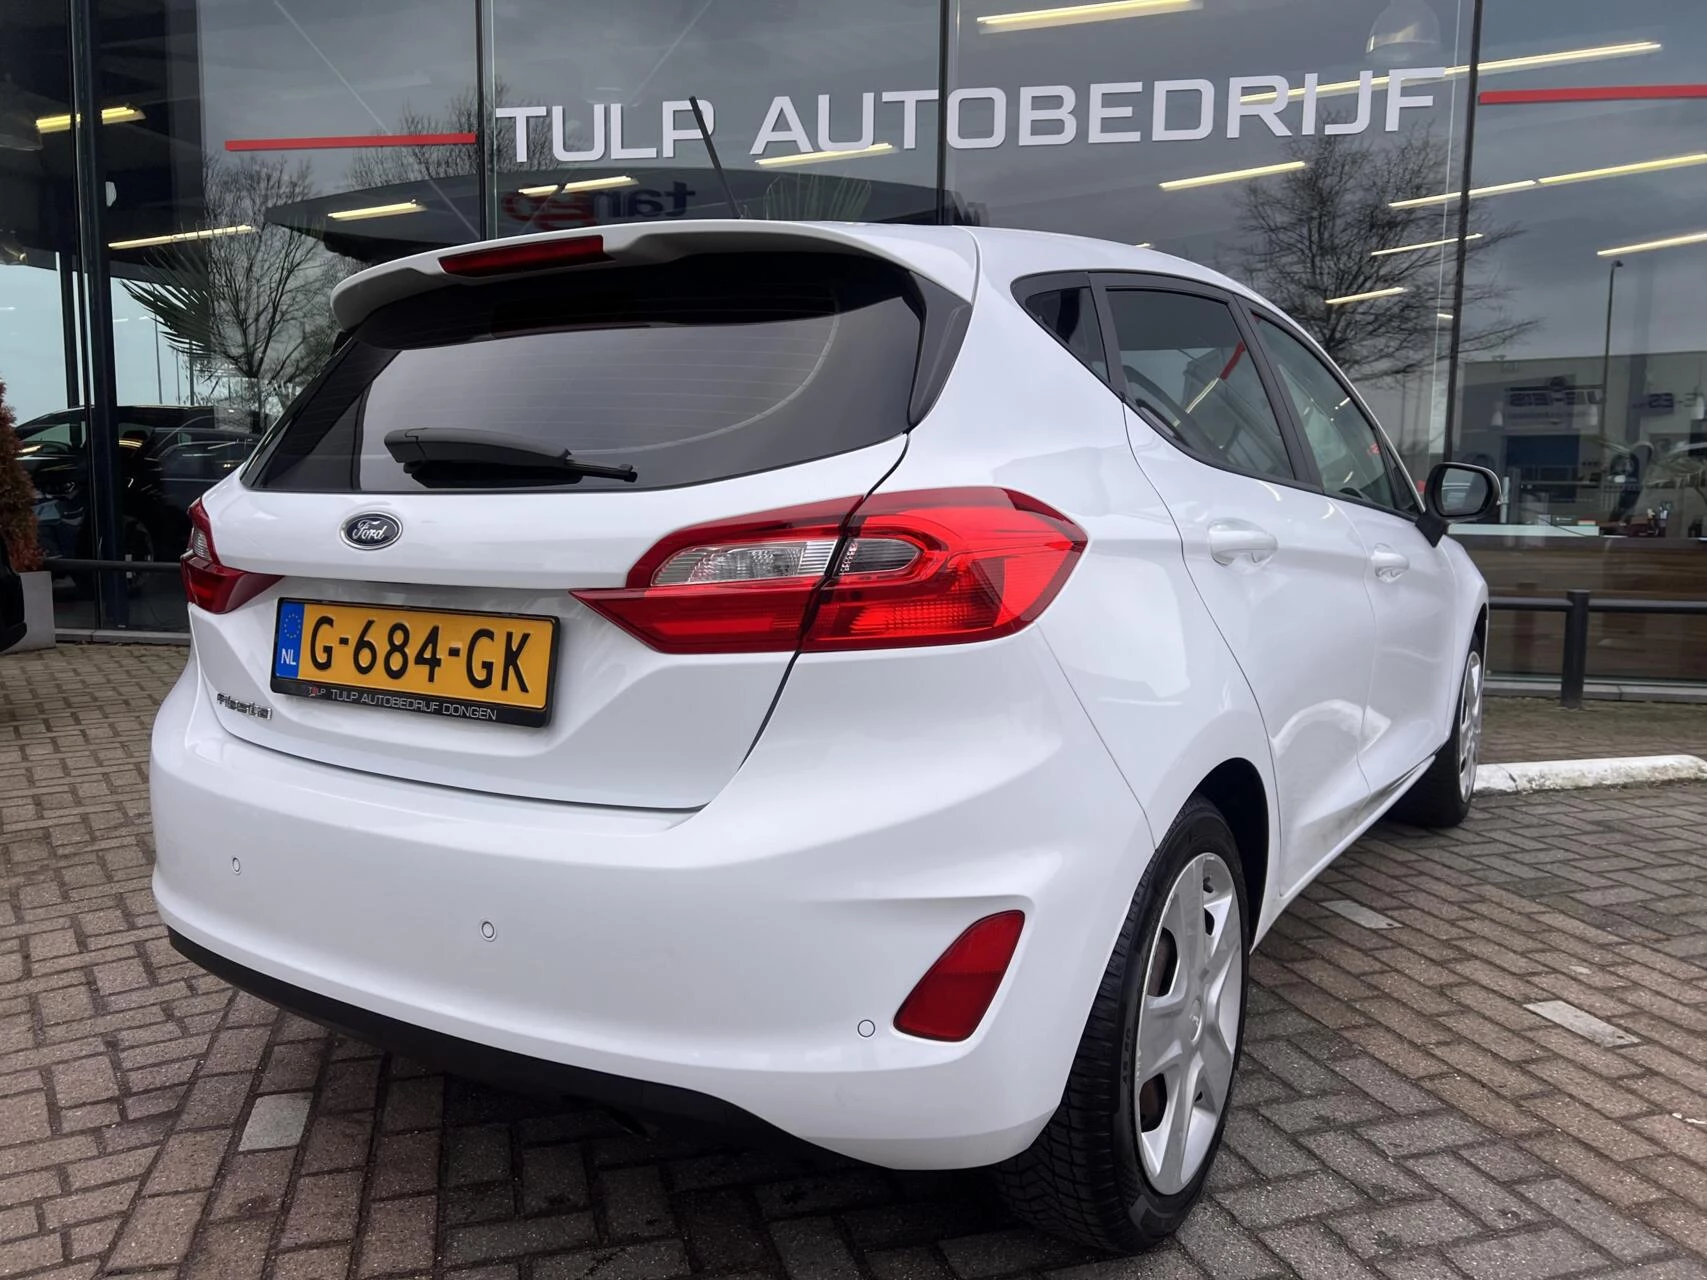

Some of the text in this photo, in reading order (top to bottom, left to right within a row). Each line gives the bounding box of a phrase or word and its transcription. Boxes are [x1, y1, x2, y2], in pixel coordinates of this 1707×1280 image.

[495, 67, 1446, 163] TULP AUTOBEDRIJF
[352, 519, 388, 540] Ford
[280, 648, 297, 665] NL
[309, 615, 531, 694] G-684-GK
[331, 689, 497, 721] TULP AUTOBEDRIJF DONGEN
